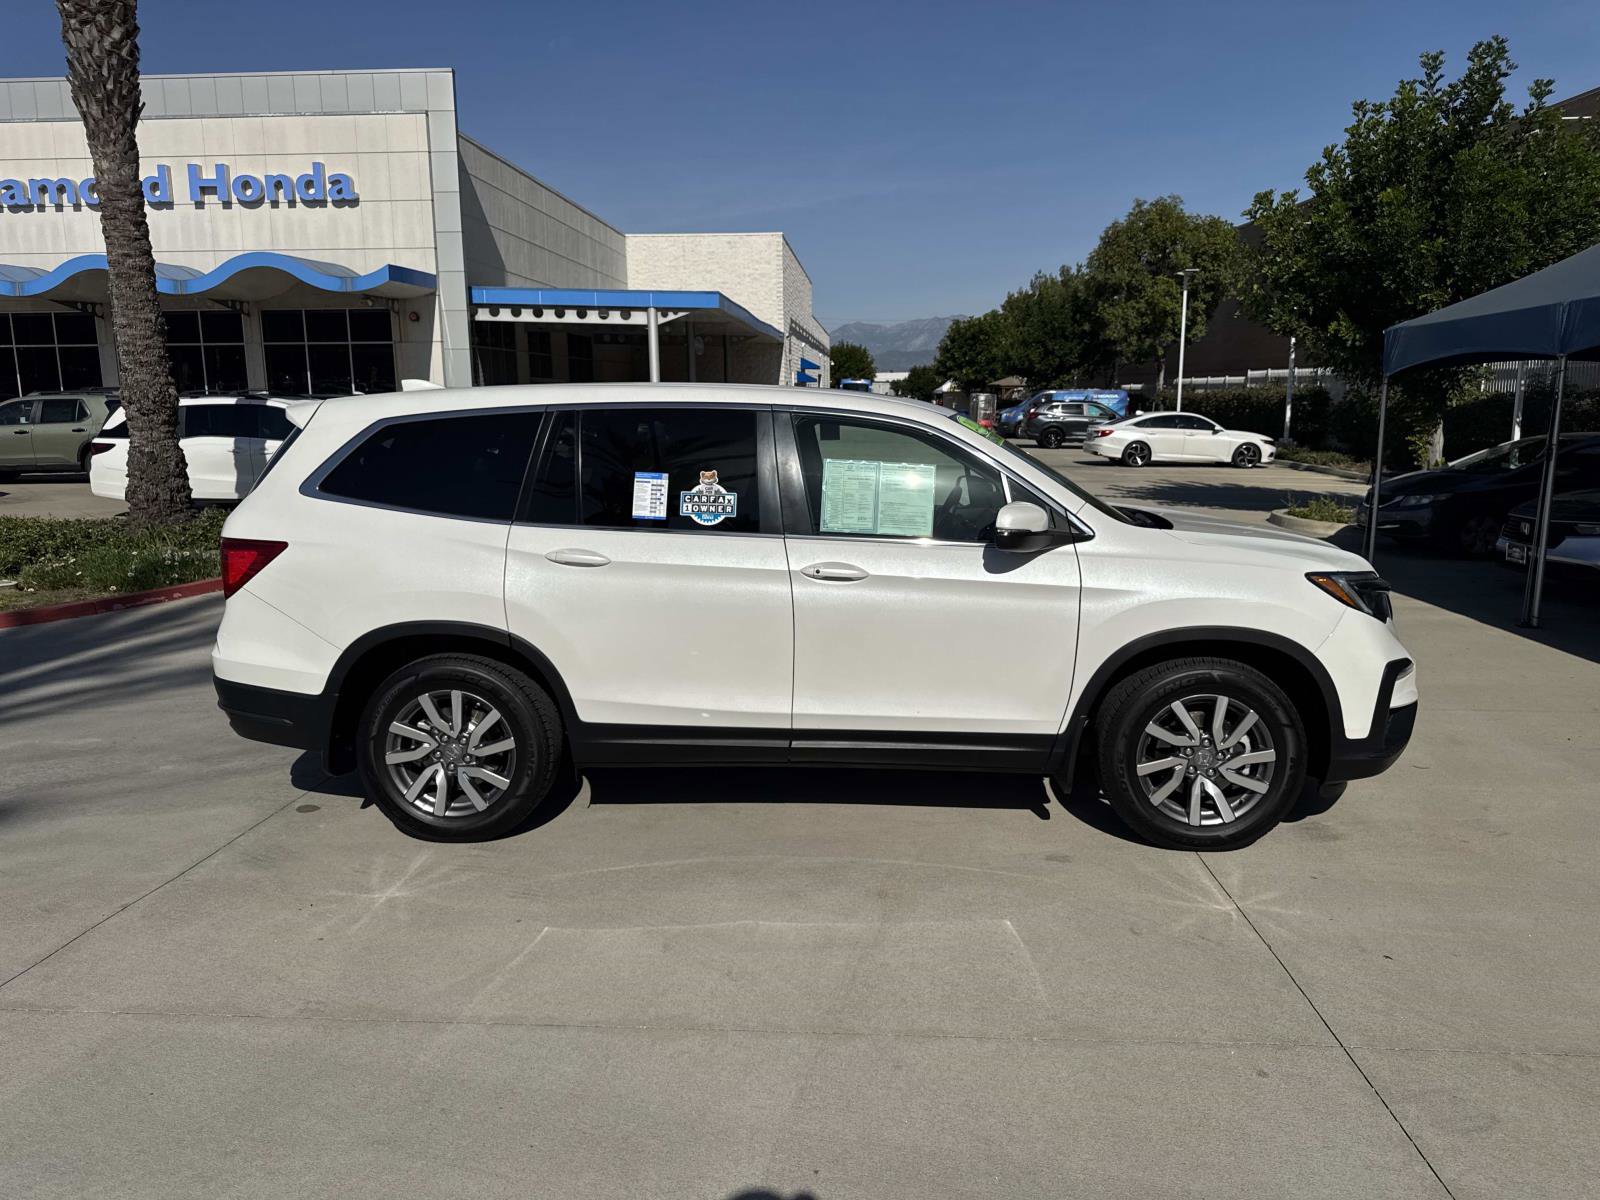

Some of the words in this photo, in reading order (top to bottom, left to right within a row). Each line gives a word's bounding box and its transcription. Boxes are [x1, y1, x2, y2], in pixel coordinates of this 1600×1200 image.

[0, 164, 171, 206] amod
[187, 162, 358, 202] Honda
[684, 495, 733, 505] CARFAX
[692, 505, 732, 513] OWNER
